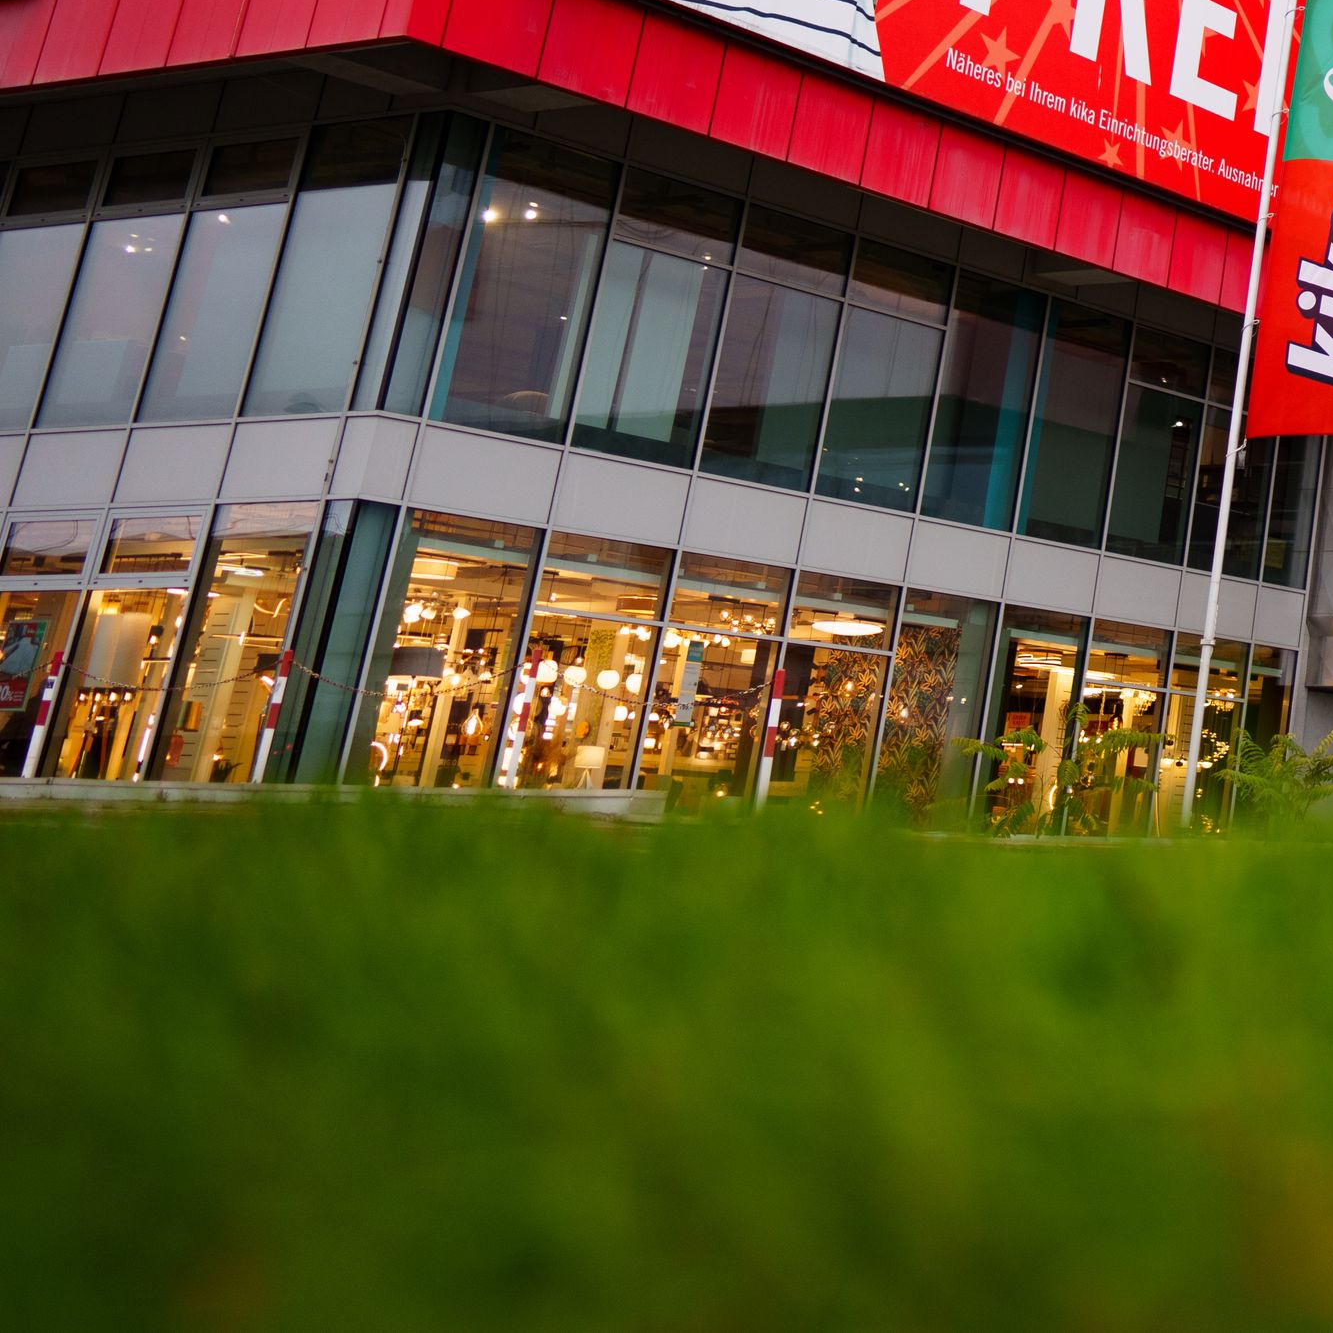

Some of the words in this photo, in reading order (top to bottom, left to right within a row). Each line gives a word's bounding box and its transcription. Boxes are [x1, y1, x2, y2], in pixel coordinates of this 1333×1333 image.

[946, 46, 1003, 88] Näheres
[1006, 71, 1027, 98] bei
[1029, 81, 1067, 114] Ihrem
[1069, 97, 1096, 125] kika
[1098, 109, 1215, 174] Einrichtungsberater.
